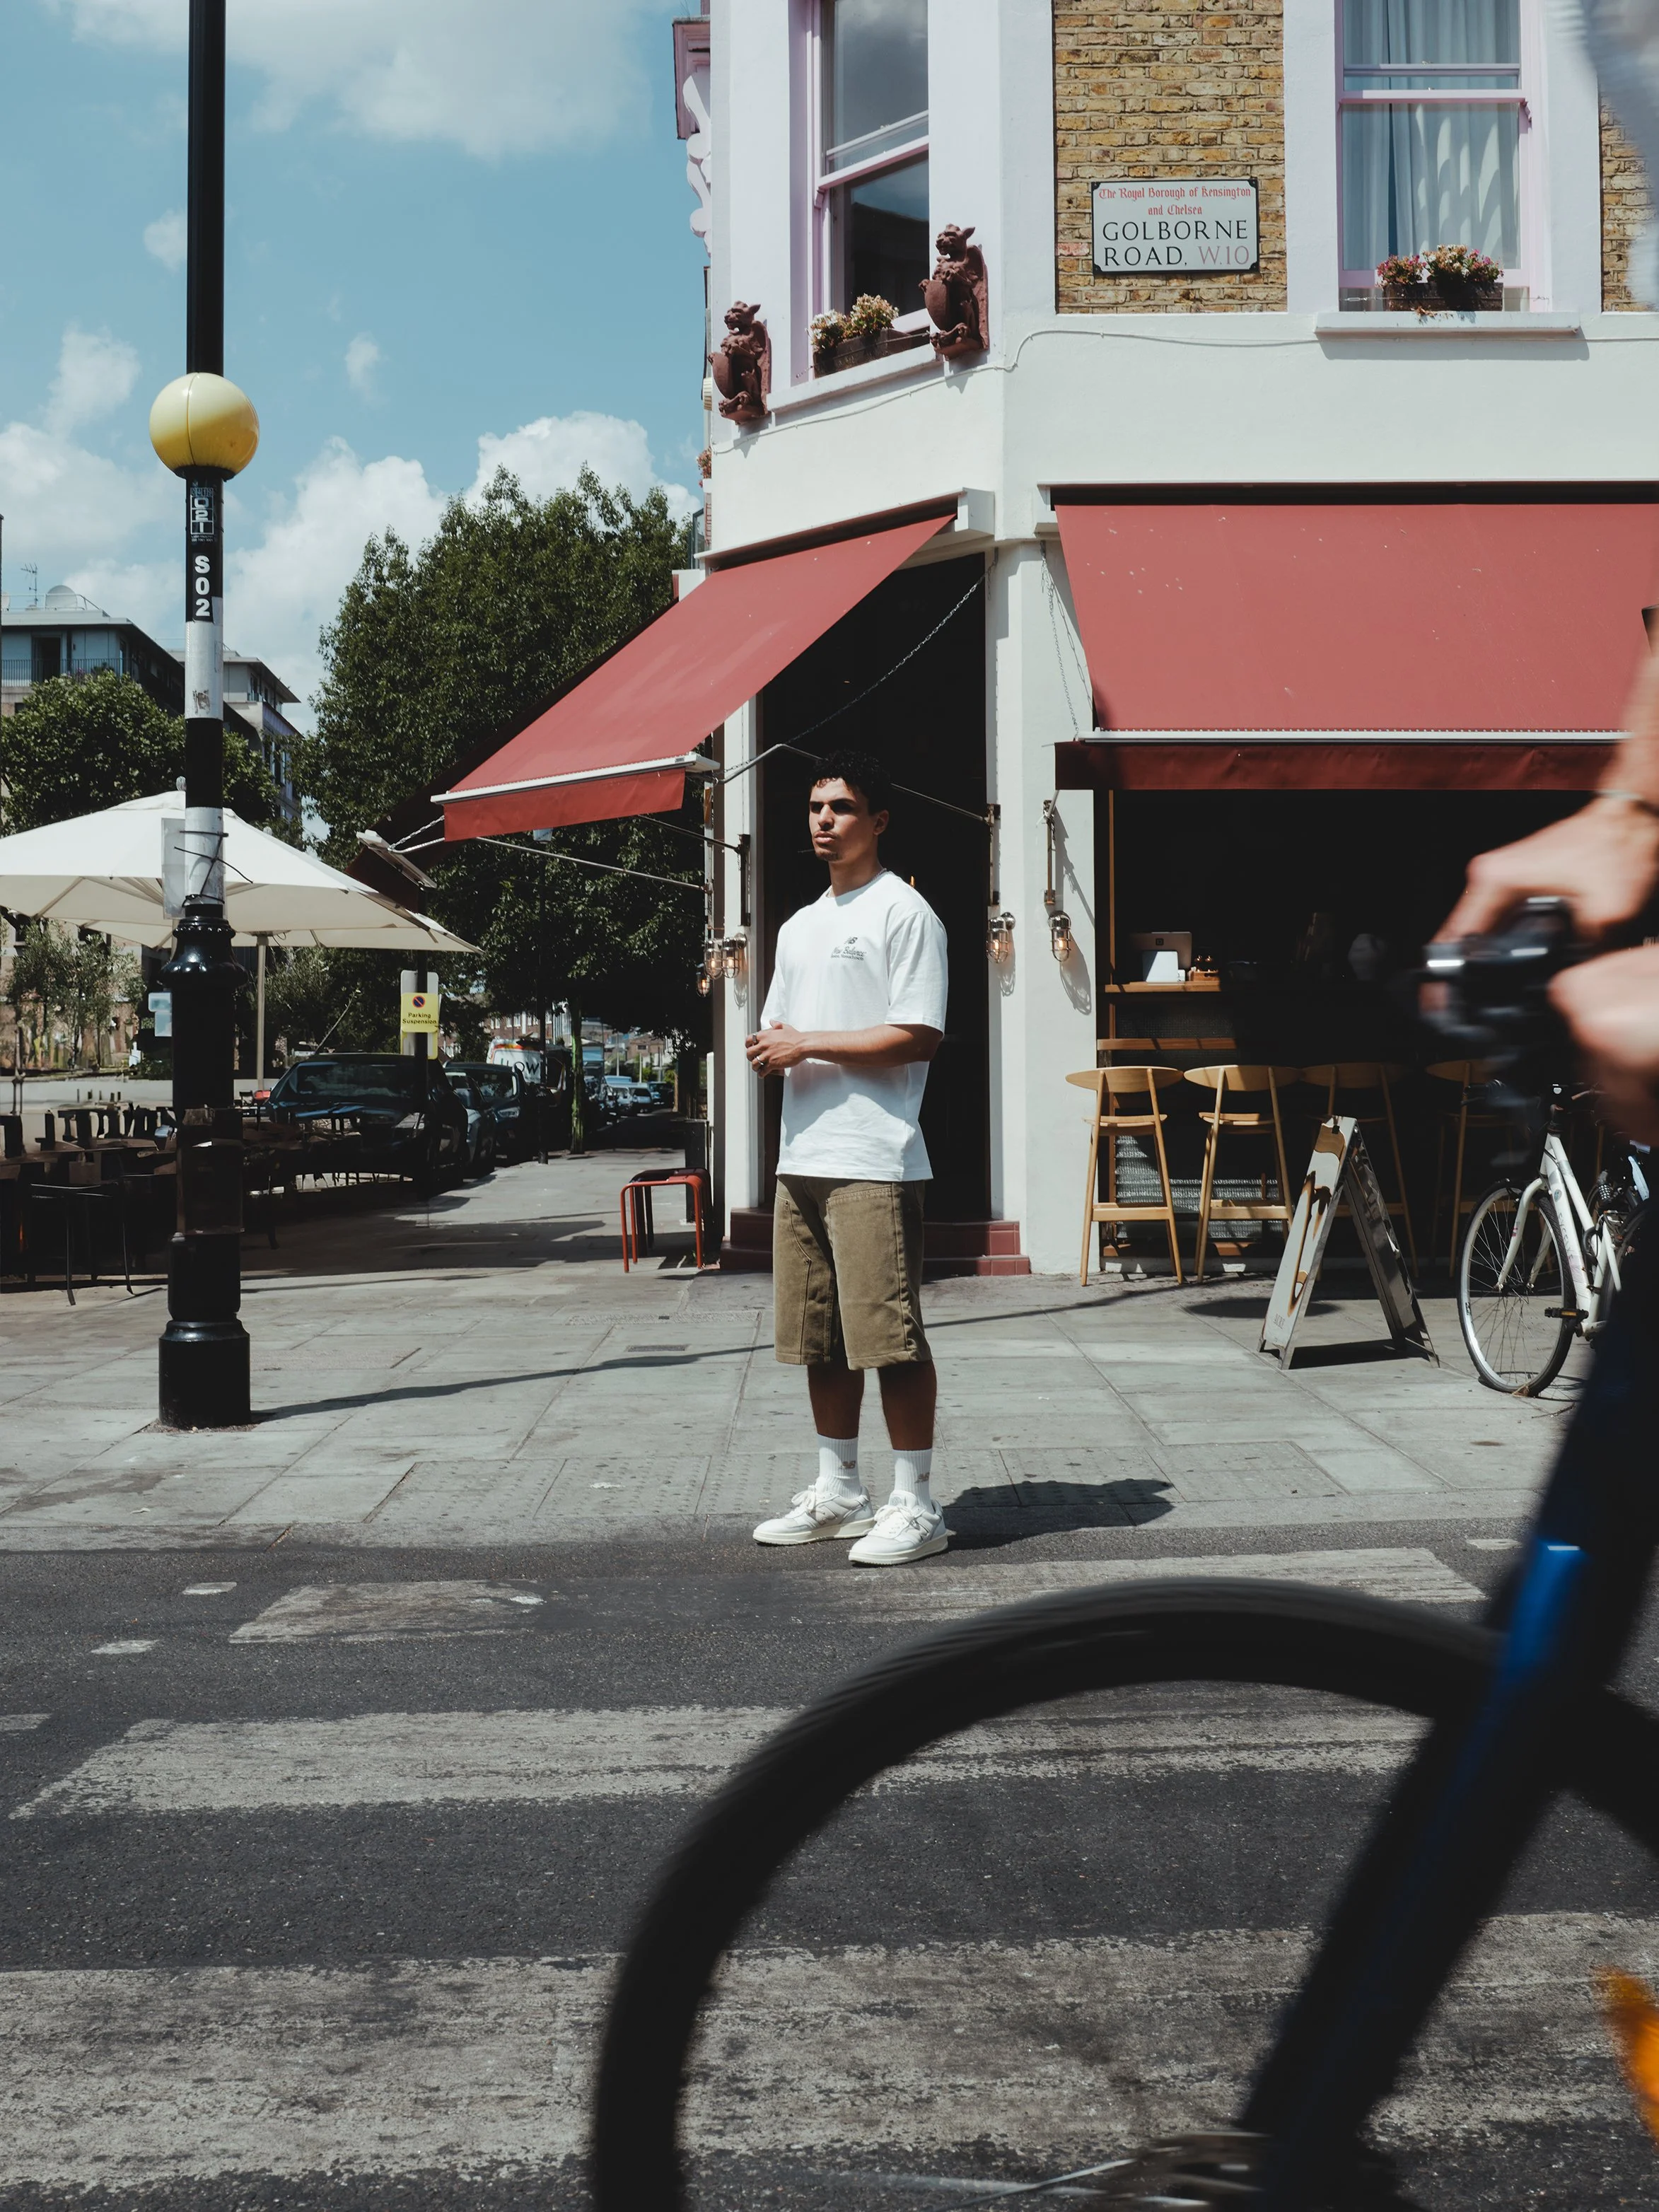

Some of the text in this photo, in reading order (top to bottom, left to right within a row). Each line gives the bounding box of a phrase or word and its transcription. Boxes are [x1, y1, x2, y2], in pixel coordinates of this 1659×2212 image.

[1099, 185, 1251, 201] The Royal Borough of Kensington
[1148, 204, 1203, 216] and Chelsea
[1102, 220, 1248, 241] GOLBORNE
[1198, 245, 1250, 265] W.10
[194, 555, 211, 617] S02
